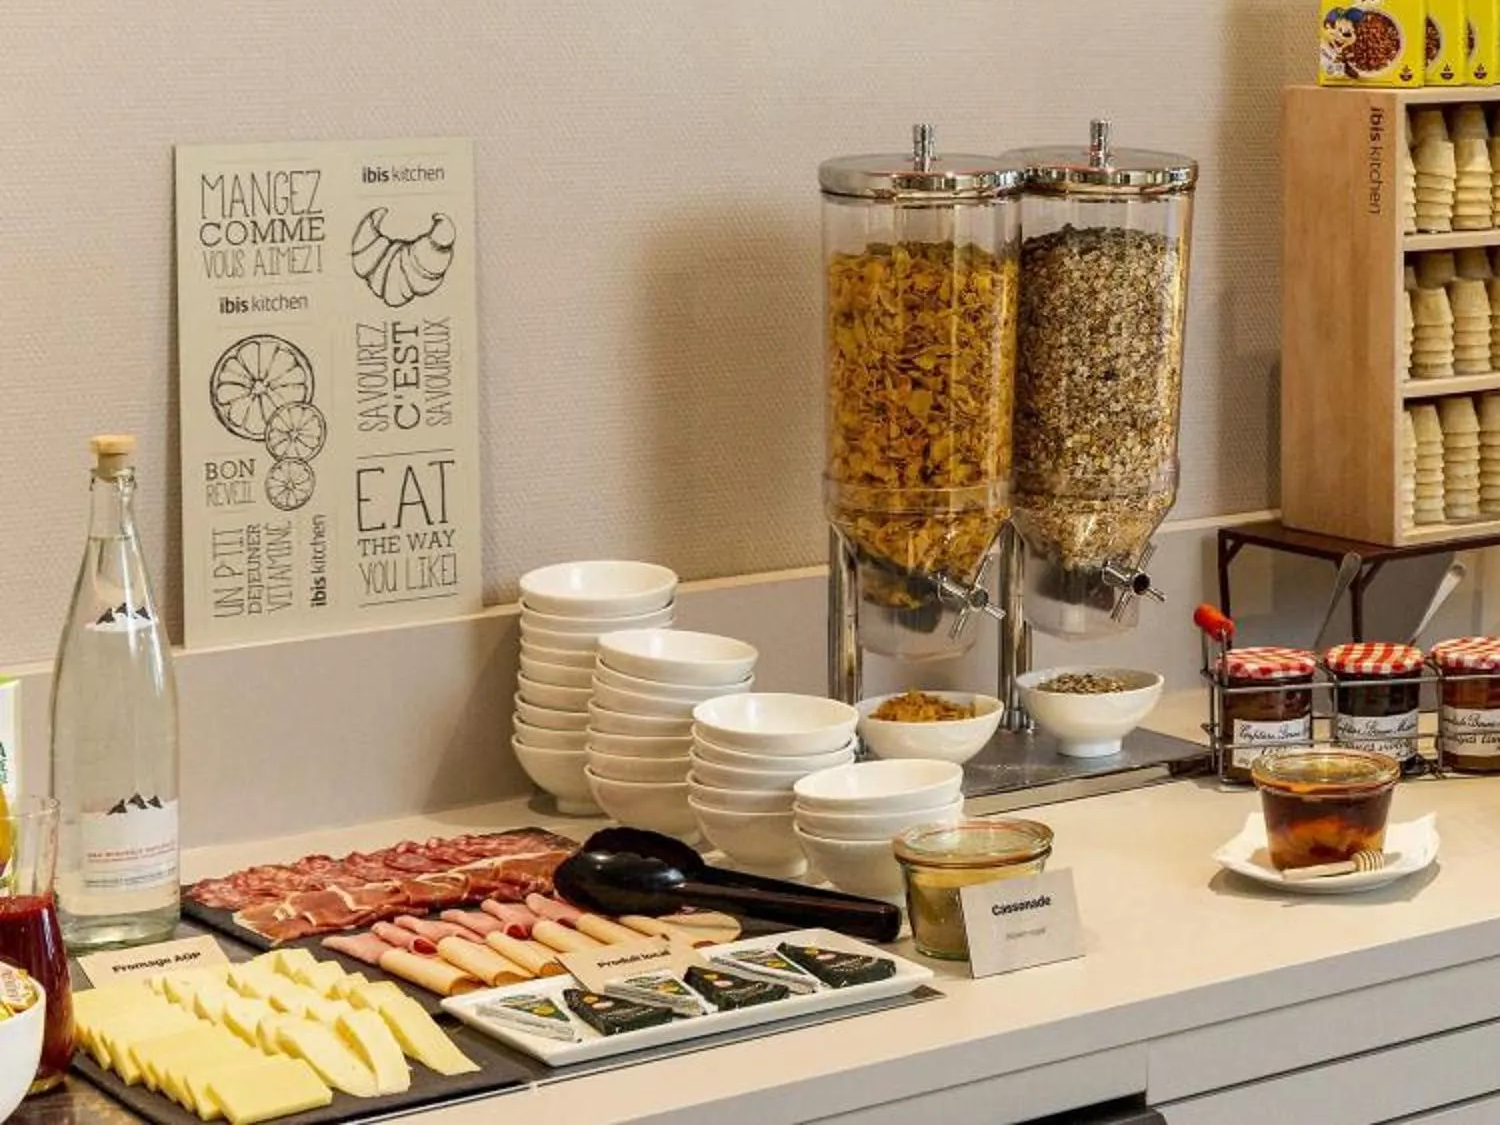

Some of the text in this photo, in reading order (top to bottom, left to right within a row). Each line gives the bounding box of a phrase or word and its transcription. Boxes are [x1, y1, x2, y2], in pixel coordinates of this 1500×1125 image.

[362, 164, 445, 183] ibis kitchen
[1369, 107, 1384, 214] ibis kitchen
[201, 170, 323, 219] MANGEZ
[200, 217, 325, 247] COMME
[202, 249, 245, 279] VOUS
[219, 293, 309, 314] ibis kitchen
[356, 321, 389, 431] SAVOUREZ
[392, 321, 421, 430] C'EST
[423, 317, 452, 427] SAVOUREUX
[204, 458, 256, 481] BON
[356, 460, 455, 532] EAT
[357, 529, 455, 557] THE WAY
[310, 514, 328, 608] ibis kitchen
[358, 559, 397, 595] YOU
[212, 586, 245, 618] UN
[991, 895, 1052, 916] Cassonade
[112, 957, 172, 973] Fromage
